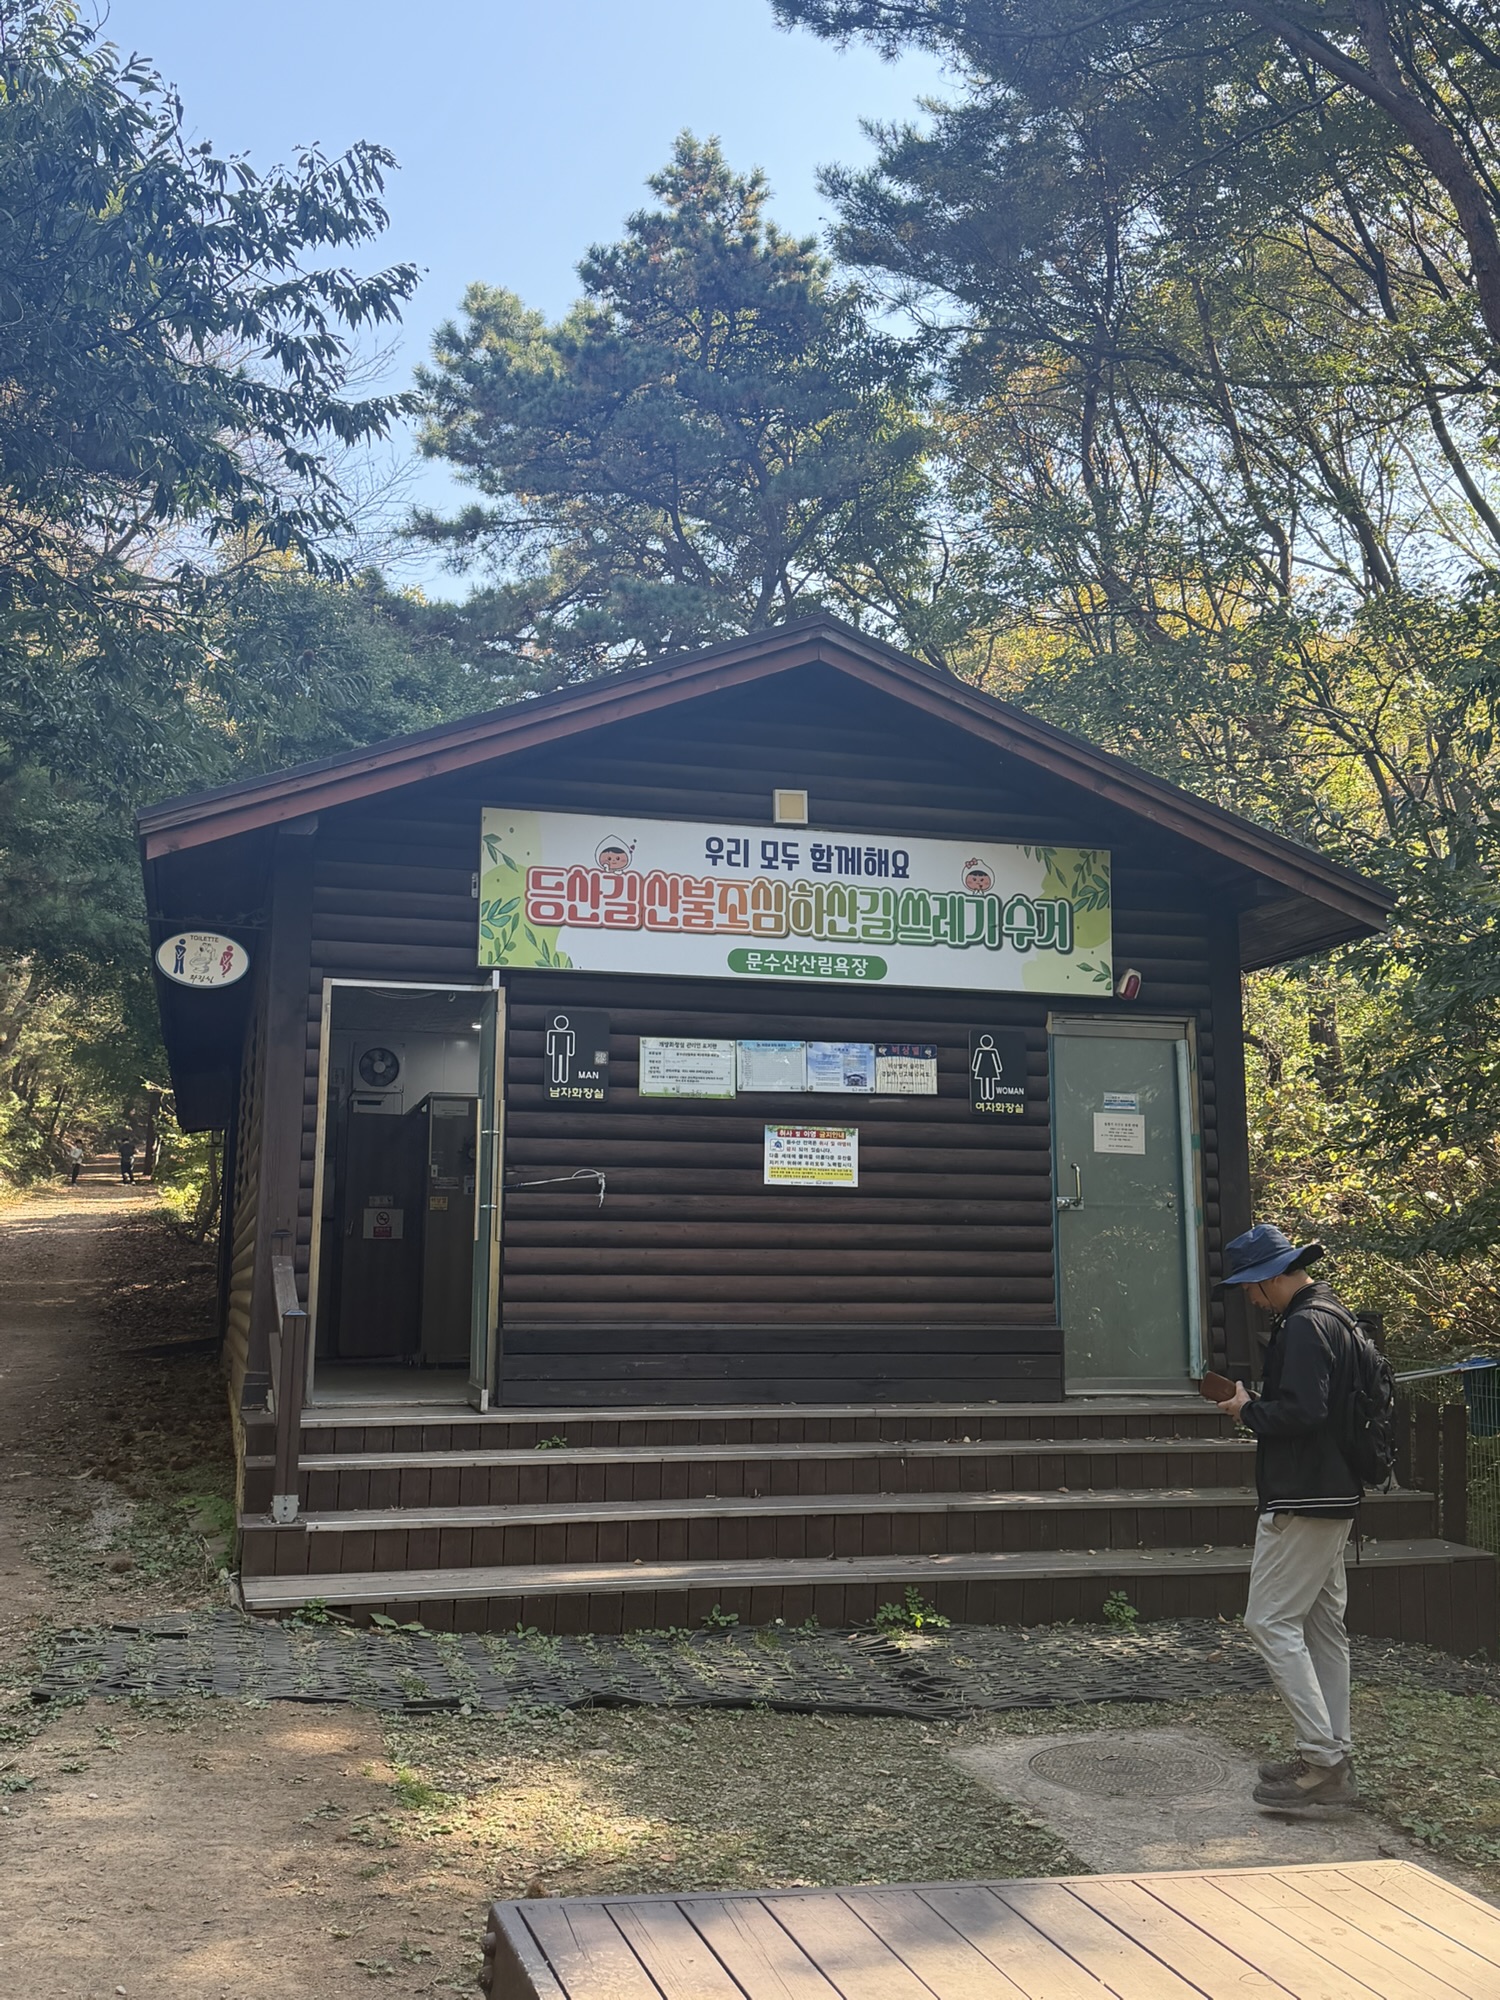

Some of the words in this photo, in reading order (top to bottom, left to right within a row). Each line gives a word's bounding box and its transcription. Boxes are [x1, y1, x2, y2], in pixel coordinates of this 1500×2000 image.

[705, 836, 750, 868] 우리
[760, 840, 800, 871] 모두
[810, 843, 910, 879] 함께해요
[525, 865, 643, 929] 등산길
[643, 869, 790, 938] 산불조심
[788, 878, 898, 945] 하산길
[897, 887, 1003, 953] 쓰레기
[1001, 893, 1075, 955] 수거
[190, 934, 220, 943] TOILETTE
[745, 952, 869, 977] 문수산산림욕장
[578, 1071, 599, 1079] MAN
[549, 1087, 604, 1099] 남자화장실
[995, 1086, 1025, 1095] WOMAN
[975, 1102, 1024, 1114] 여자화장실
